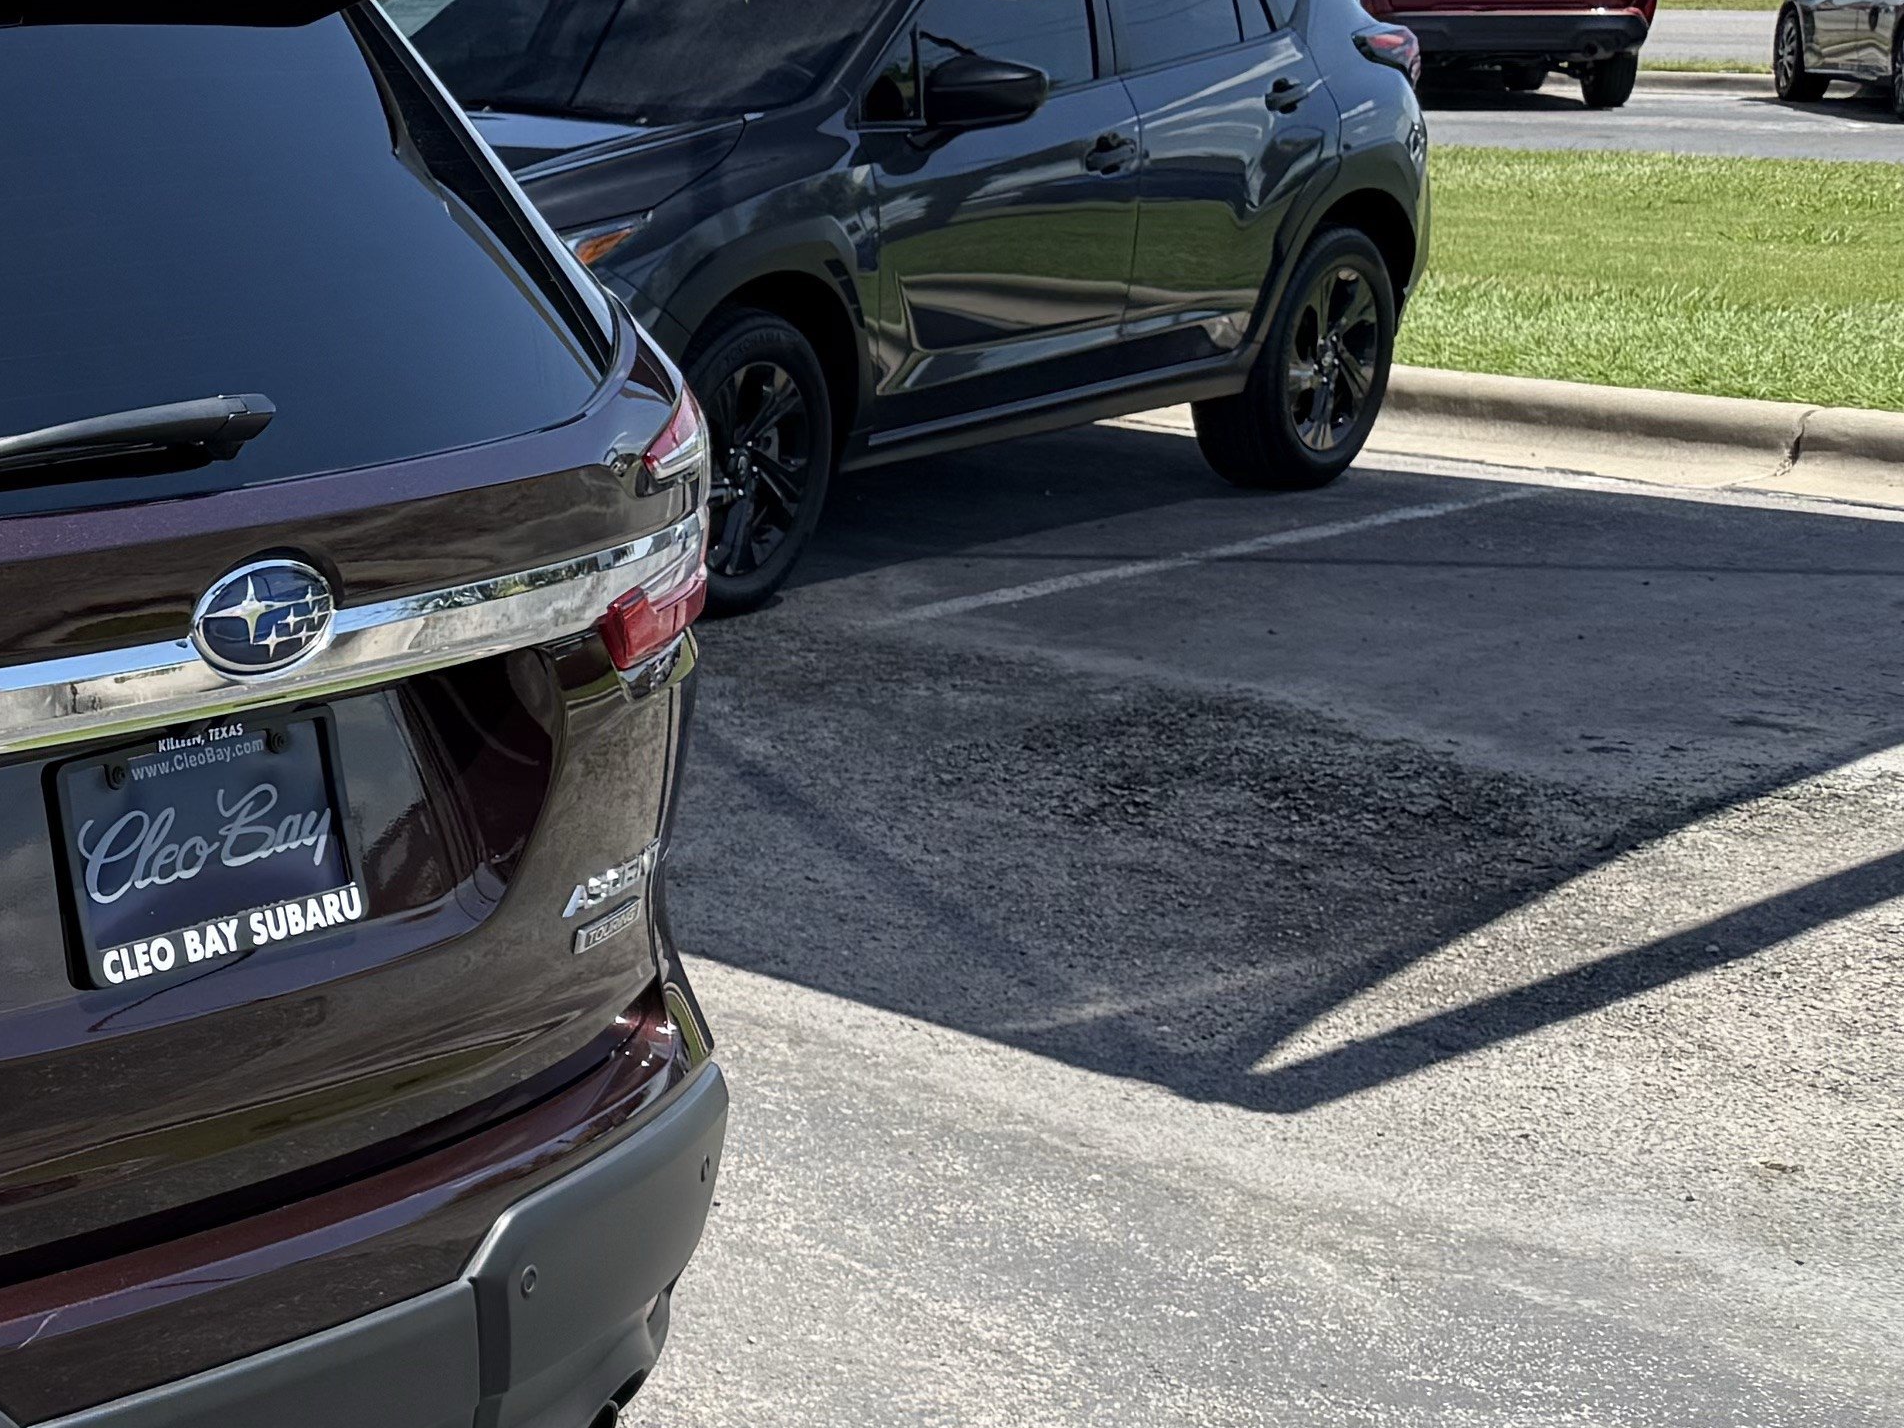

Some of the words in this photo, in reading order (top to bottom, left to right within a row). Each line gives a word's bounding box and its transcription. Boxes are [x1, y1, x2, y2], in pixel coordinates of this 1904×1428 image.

[131, 738, 265, 781] www.CleoBay.com
[208, 723, 243, 741] TEXAS
[77, 807, 219, 904] Cleo
[216, 783, 331, 866] Bay
[102, 937, 176, 984] CLEO
[183, 919, 239, 963] BAY
[249, 885, 363, 946] SUBARU
